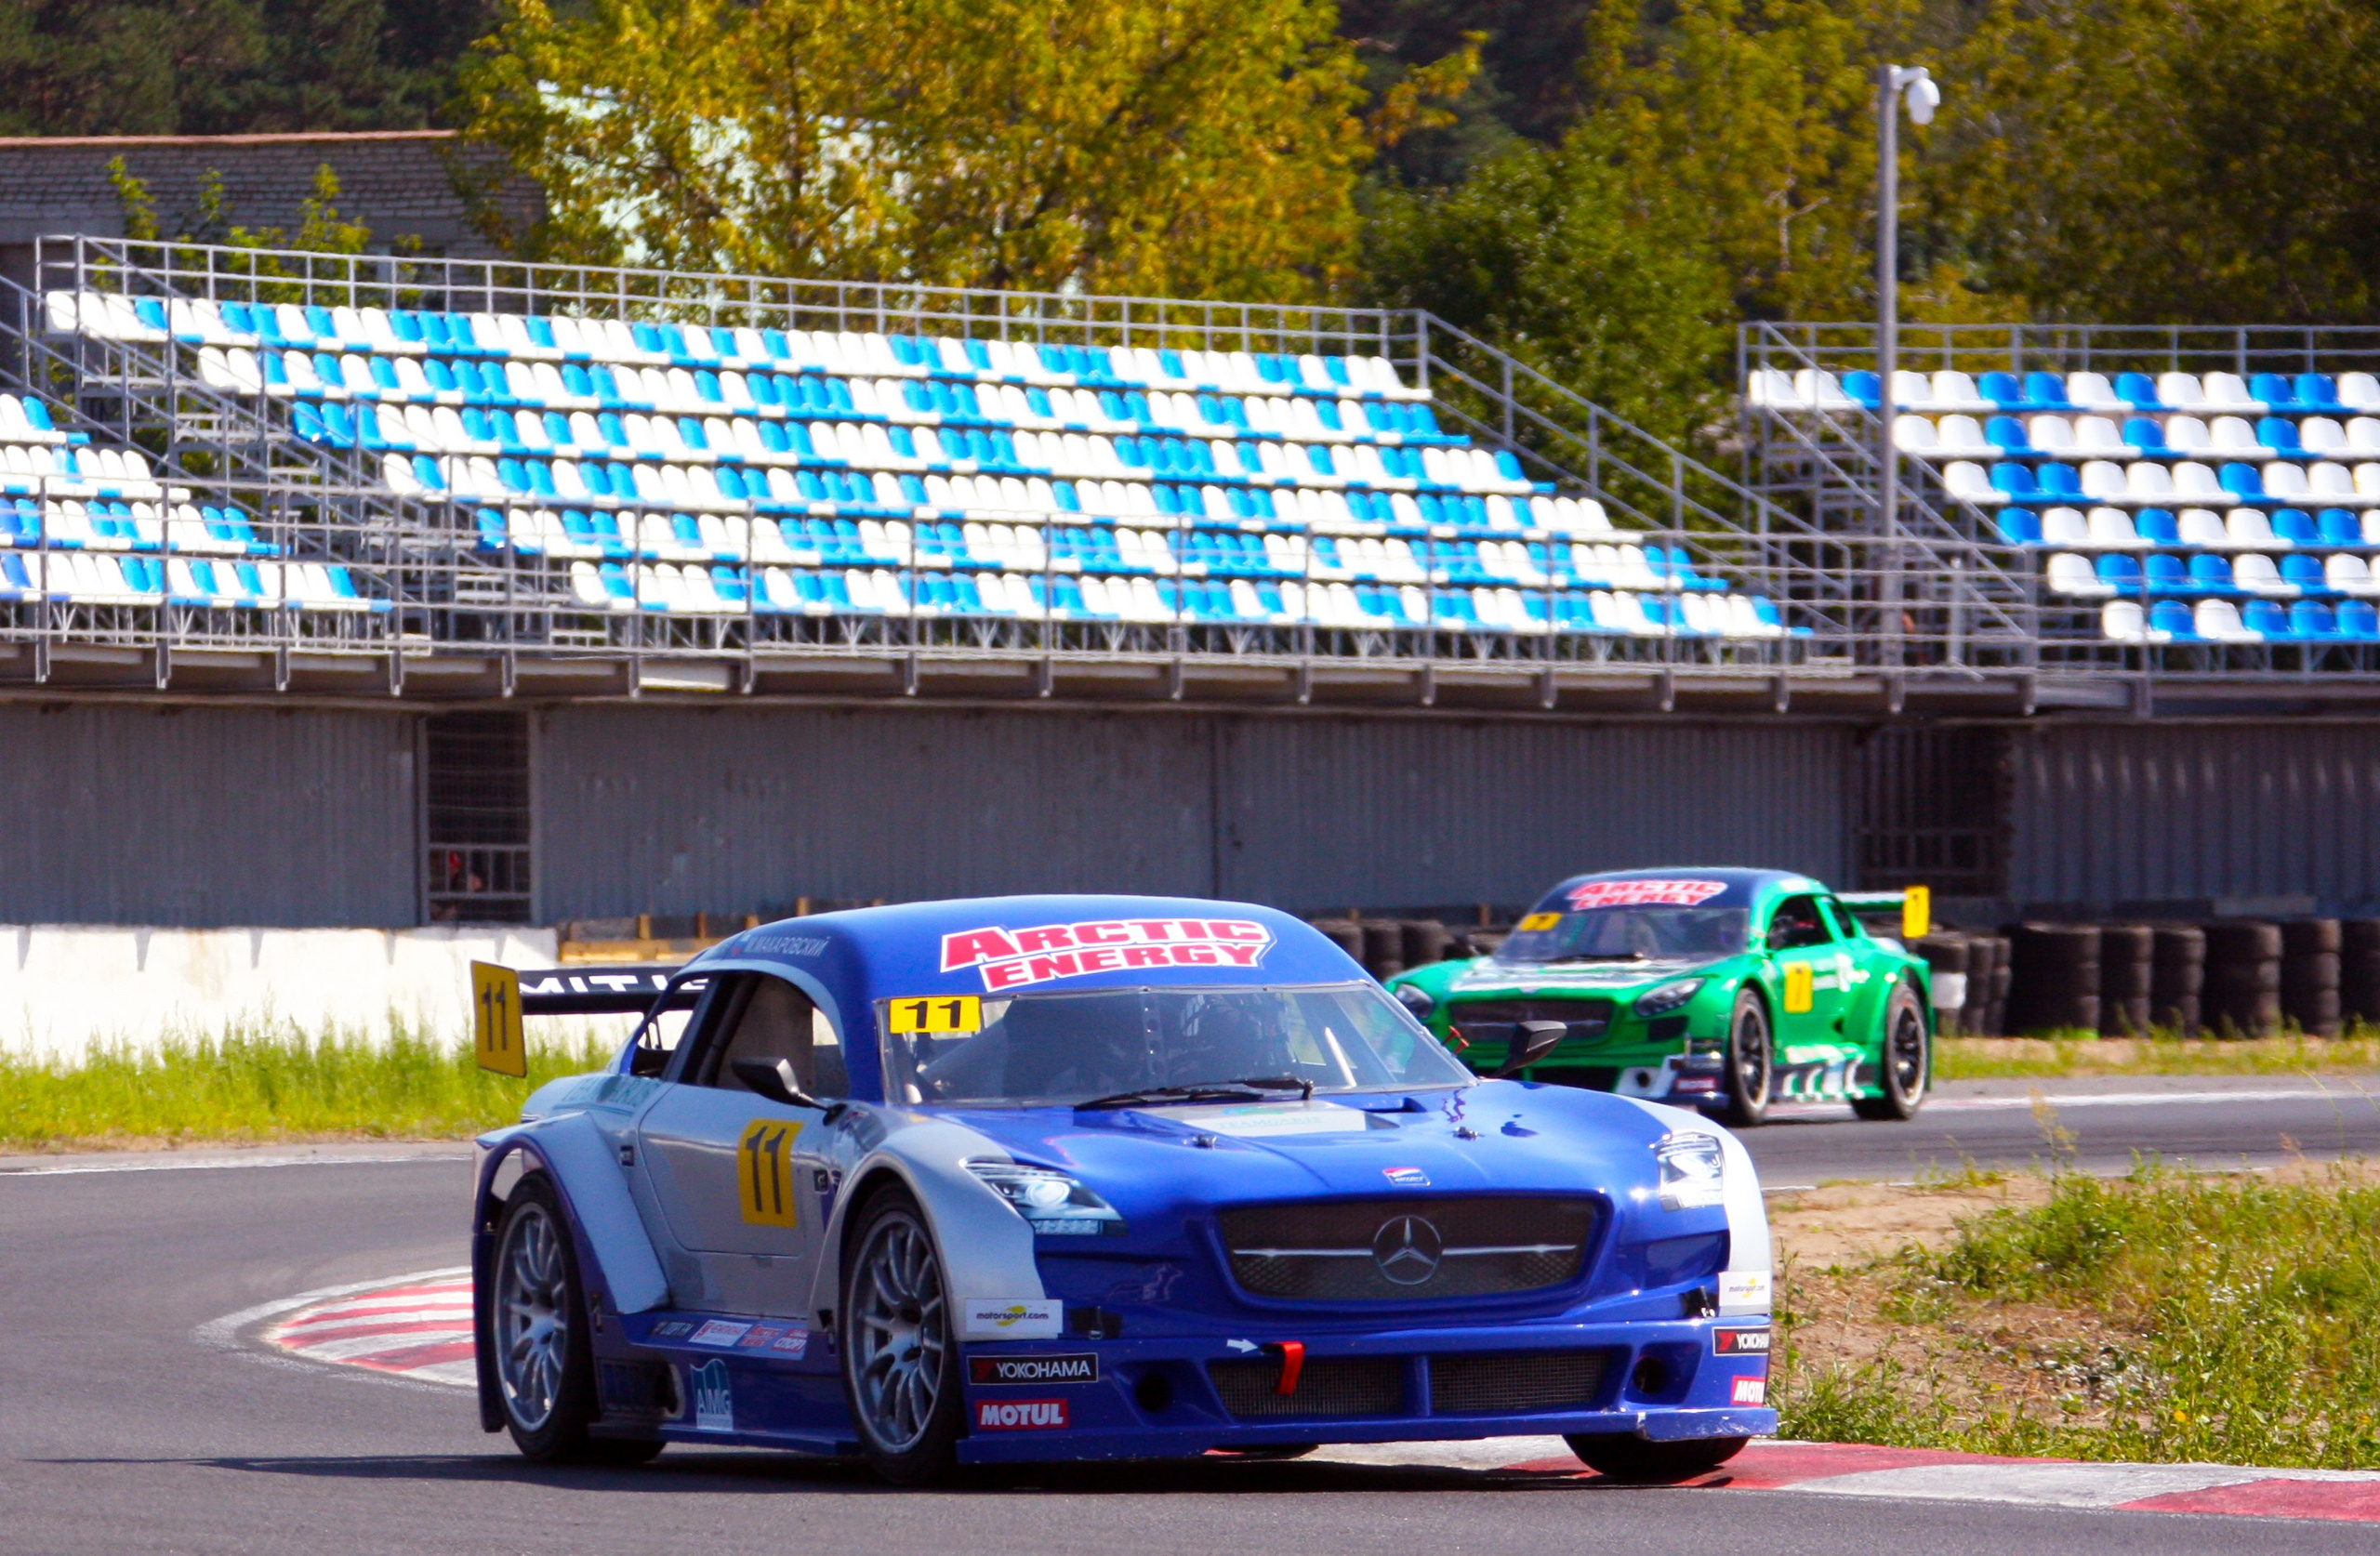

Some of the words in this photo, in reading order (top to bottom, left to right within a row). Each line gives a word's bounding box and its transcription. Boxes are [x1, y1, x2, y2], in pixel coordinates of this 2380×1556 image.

[1565, 879, 1728, 900] ARCTIC
[1572, 892, 1706, 910] ENERGY
[941, 918, 1271, 972] ARCTIC
[979, 943, 1266, 992] ENERGY
[482, 980, 507, 1052] 11
[904, 999, 961, 1029] 11
[746, 1126, 787, 1214] 11
[976, 1312, 1049, 1321] motorsport.com
[996, 1360, 1091, 1378] YOKOHAMA
[981, 1403, 1064, 1426] MOTUL
